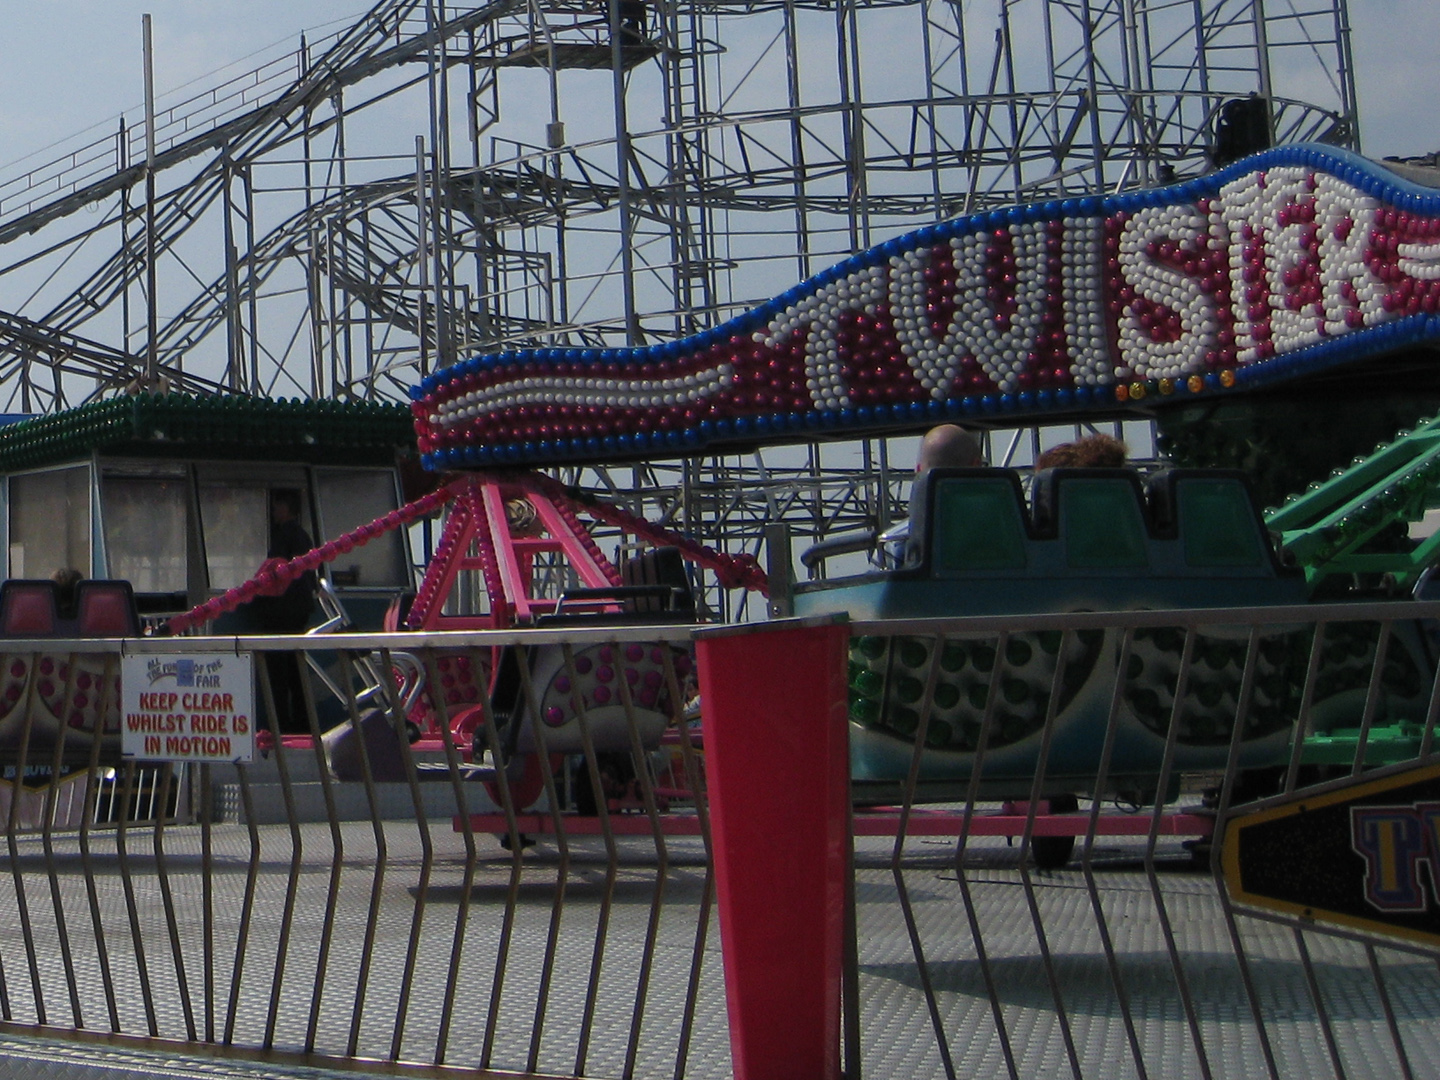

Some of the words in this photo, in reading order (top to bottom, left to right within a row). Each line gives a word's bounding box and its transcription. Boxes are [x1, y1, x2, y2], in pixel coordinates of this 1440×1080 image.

[753, 166, 1389, 411] TWISTER
[194, 663, 205, 674] OF
[206, 659, 223, 674] THE
[196, 674, 221, 688] FAIR
[139, 692, 178, 712] KEEP
[182, 693, 234, 712] CLEAR
[126, 713, 186, 733] WHILST
[190, 714, 228, 734] RIDE
[232, 714, 249, 735] IS
[144, 735, 161, 755] IN
[165, 736, 231, 756] MOTION
